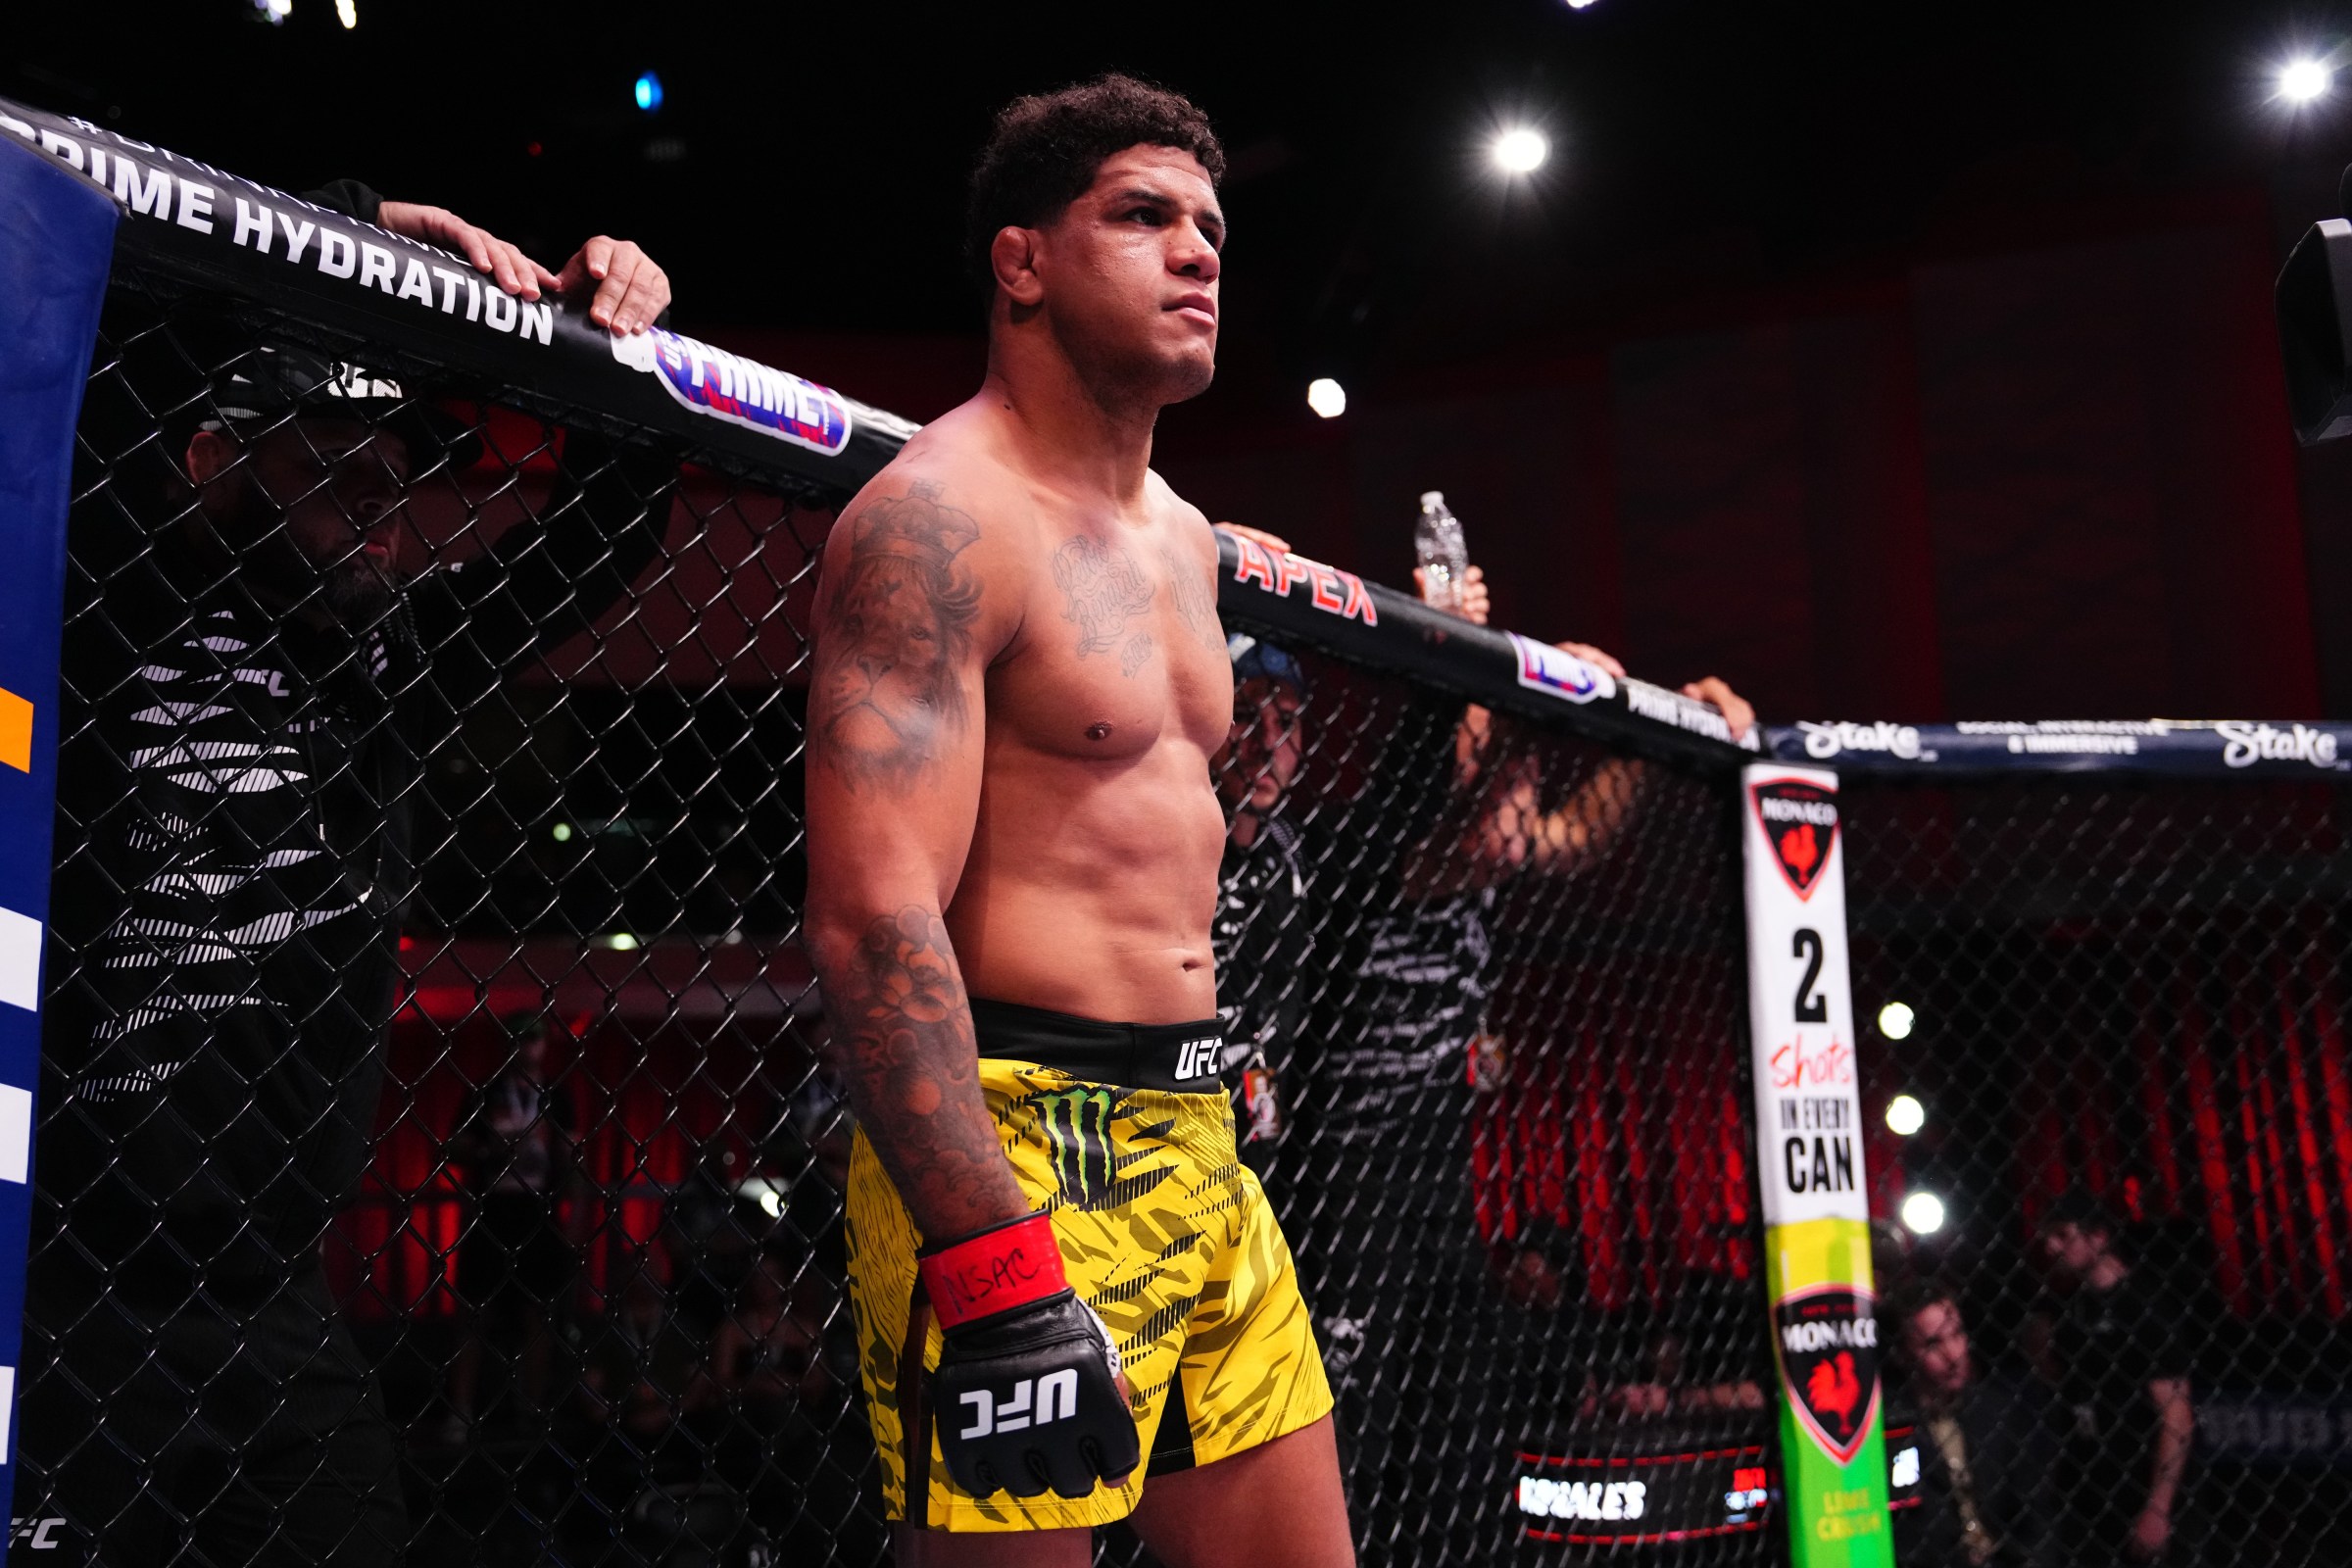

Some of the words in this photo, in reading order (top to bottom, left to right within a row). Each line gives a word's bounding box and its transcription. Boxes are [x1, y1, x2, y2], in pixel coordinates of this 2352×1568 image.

[232, 197, 554, 346] HYDRATION
[1233, 537, 1379, 628] APEX
[1795, 720, 1921, 760] Stake
[2215, 720, 2337, 768] Stake
[1760, 797, 1838, 827] MONACO
[1792, 928, 1828, 1024] 2
[1175, 1036, 1223, 1081] UFC
[1779, 1098, 1798, 1130] IN
[1803, 1098, 1850, 1130] EVERY
[1785, 1136, 1855, 1194] CAN
[941, 1247, 1044, 1316] NSAC
[958, 1368, 1079, 1442] UFC
[7, 1517, 68, 1549] FC
